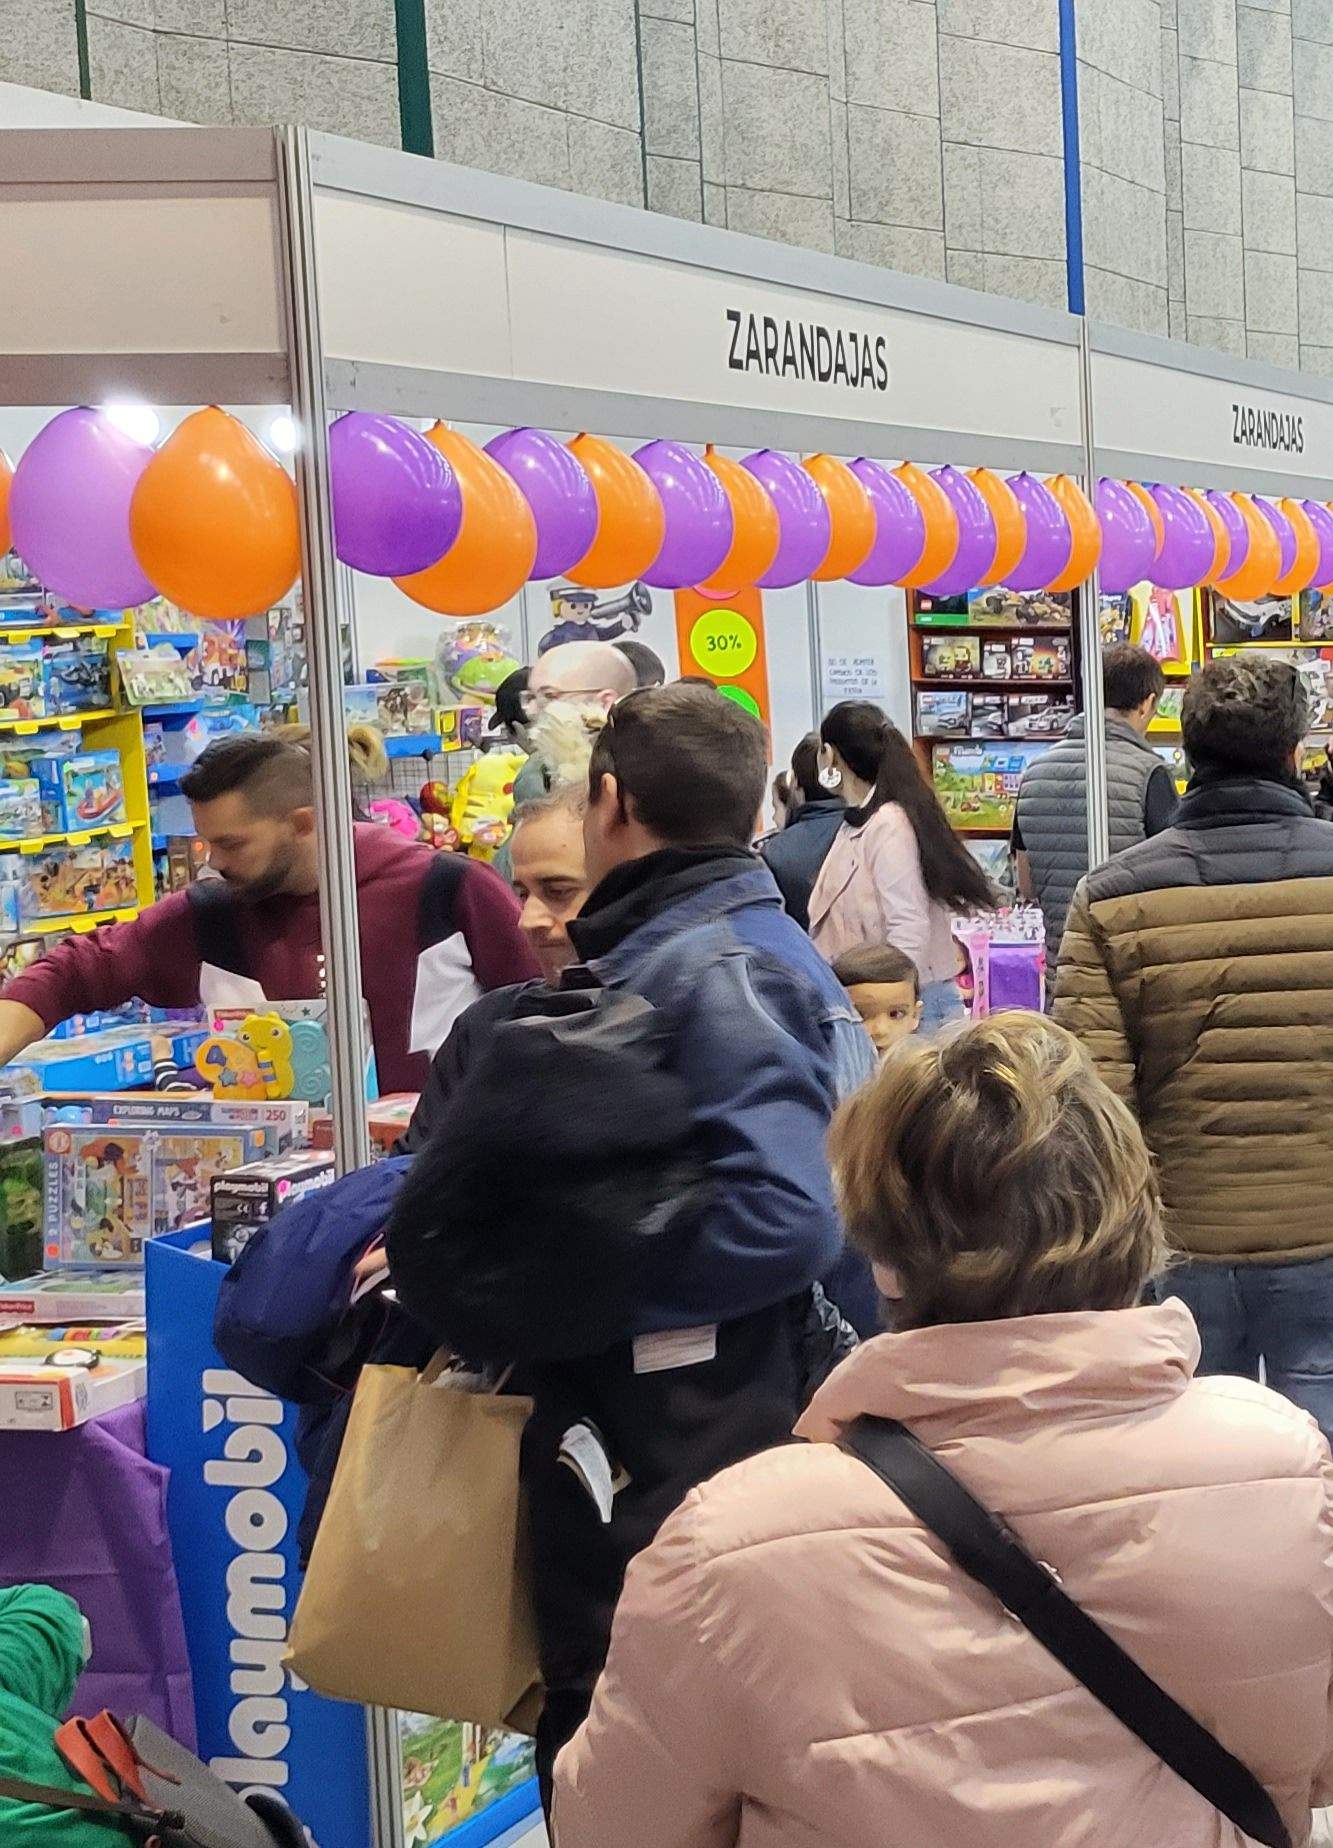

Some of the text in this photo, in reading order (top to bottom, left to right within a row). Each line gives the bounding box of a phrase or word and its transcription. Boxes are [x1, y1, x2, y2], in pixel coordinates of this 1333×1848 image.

[725, 309, 889, 392] ZARANDAJAS
[1231, 404, 1305, 455] ZARANDAJAS
[706, 634, 742, 652] 30%
[113, 1104, 181, 1118] EXPLORING MAPS
[265, 1109, 286, 1122] 250
[49, 1162, 58, 1222] PUZZLES
[213, 1182, 270, 1194] playmobil
